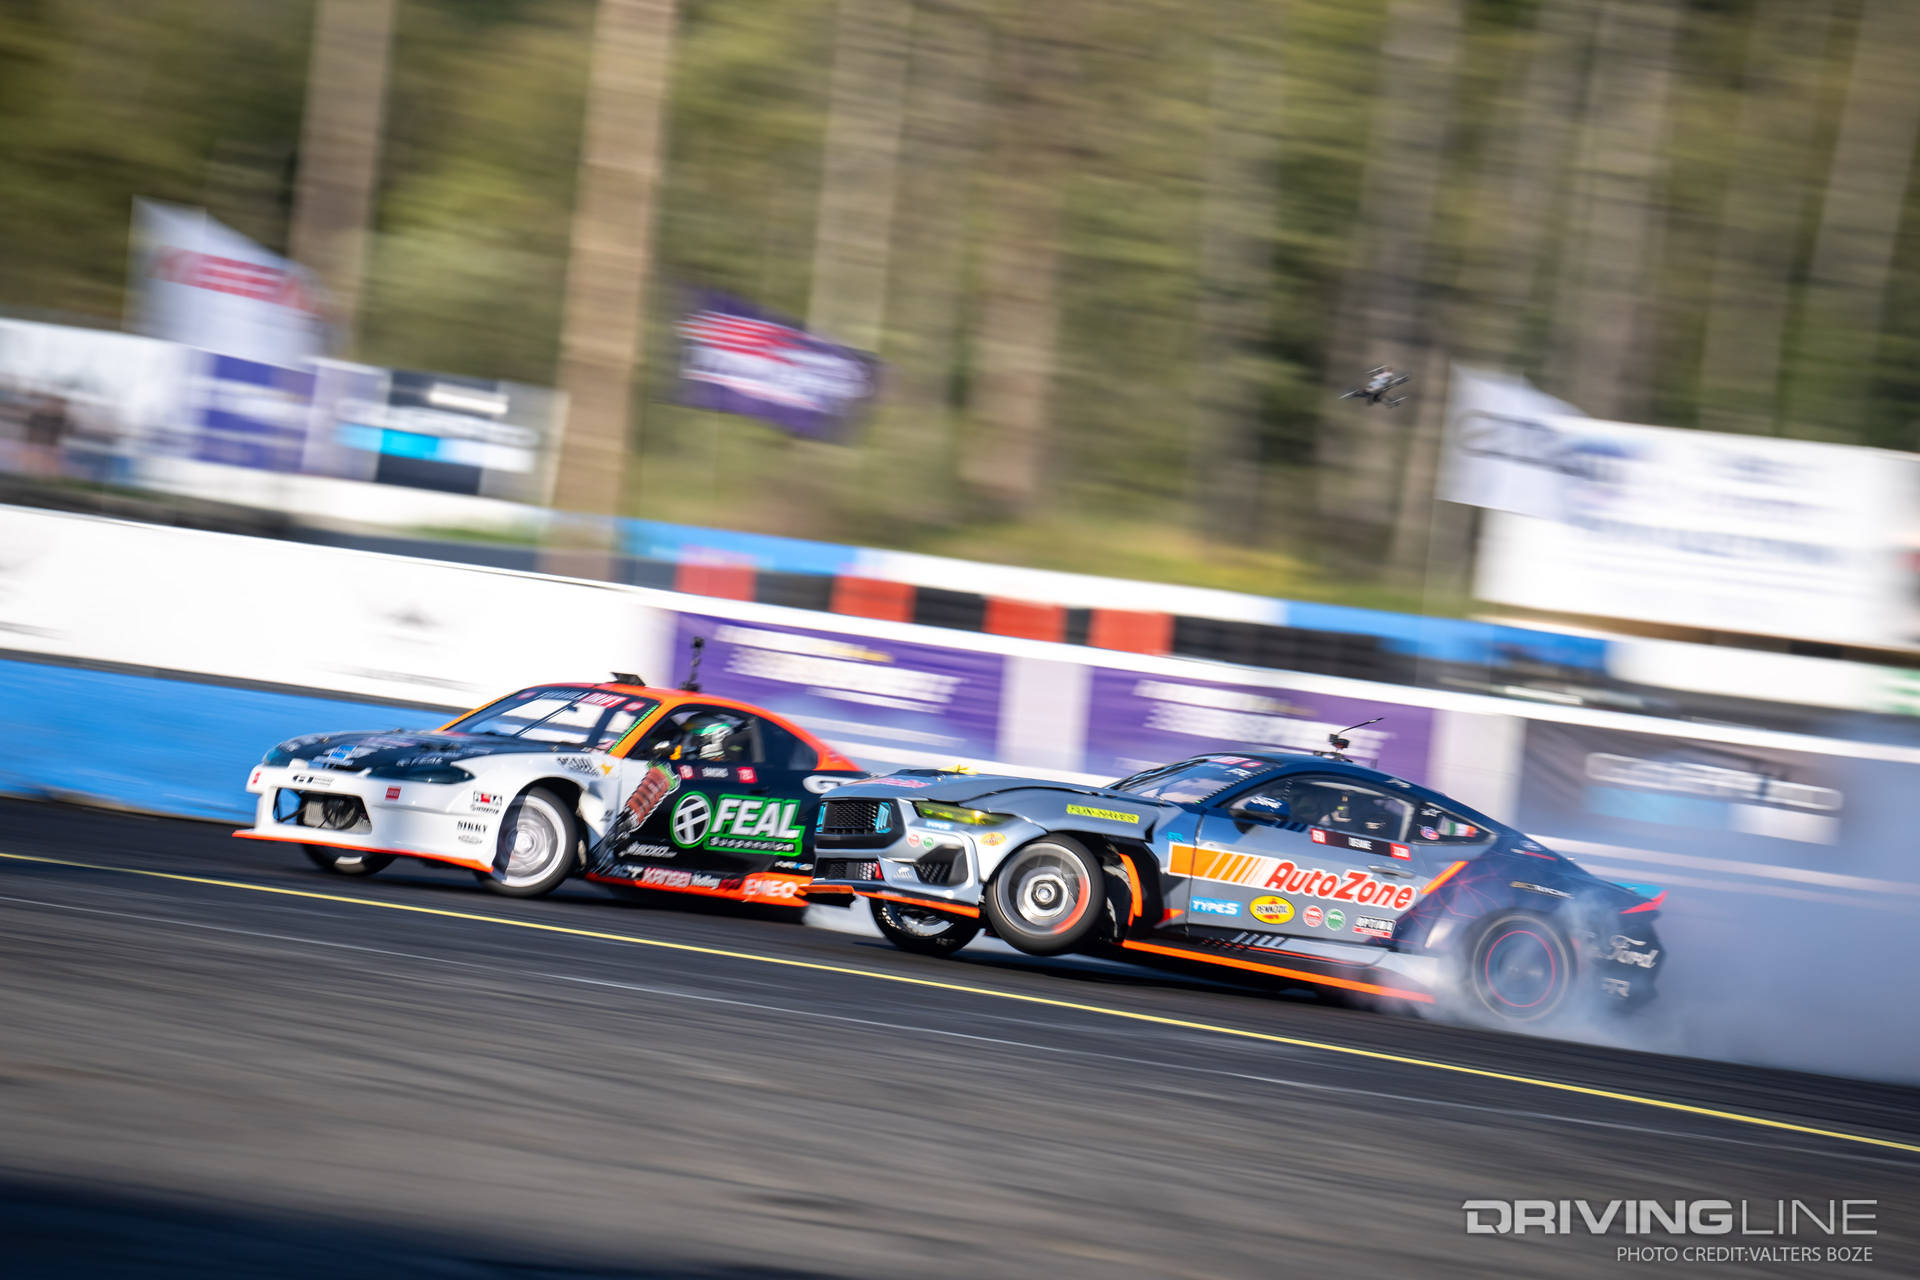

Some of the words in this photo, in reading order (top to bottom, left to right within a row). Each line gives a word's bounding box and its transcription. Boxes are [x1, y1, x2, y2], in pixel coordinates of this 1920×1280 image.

[711, 796, 800, 840] FEAL
[710, 836, 795, 852] Suspension
[743, 879, 799, 899] ENEO
[1264, 861, 1415, 911] AutoZone
